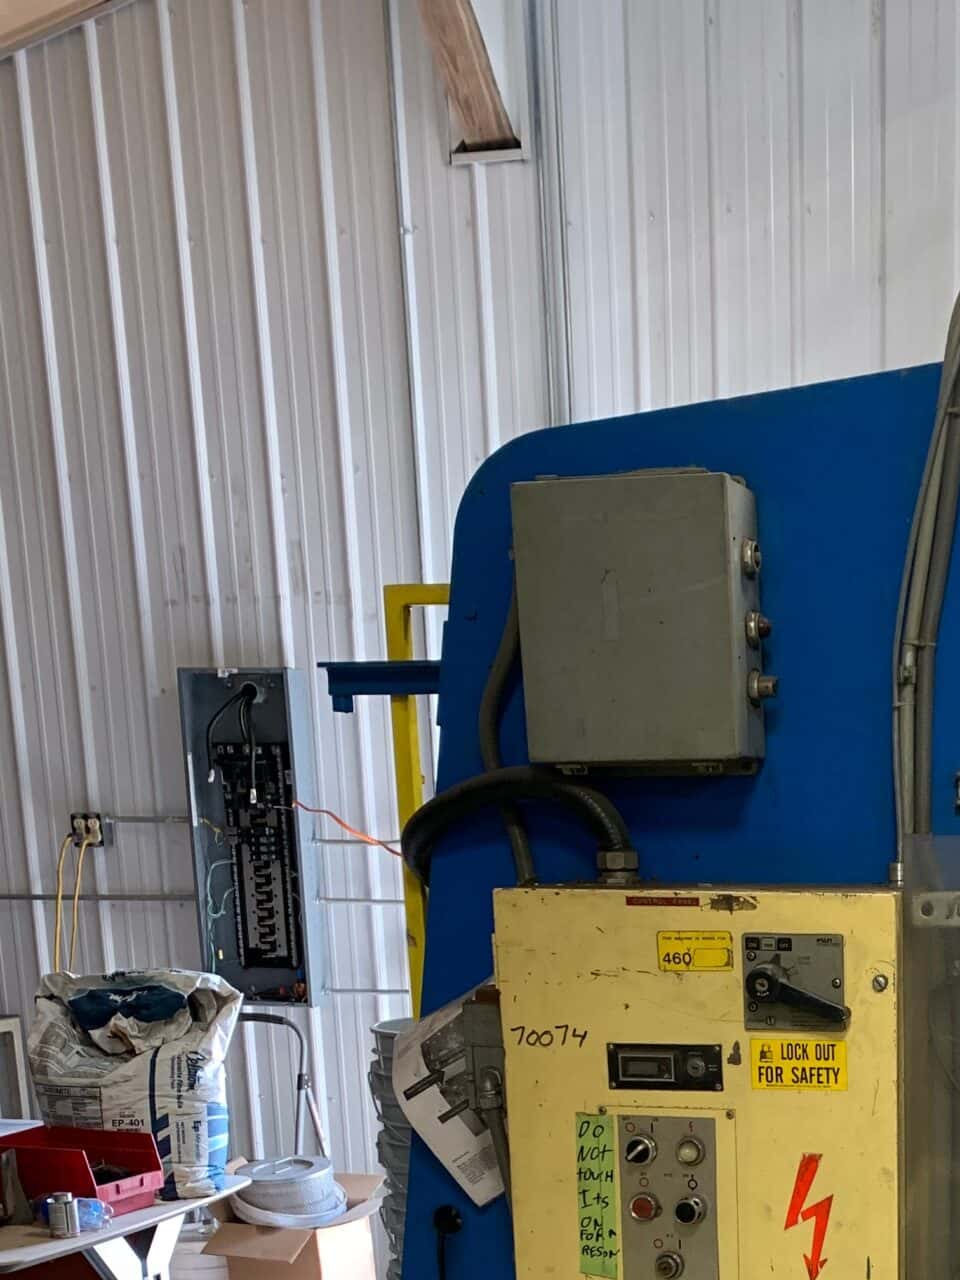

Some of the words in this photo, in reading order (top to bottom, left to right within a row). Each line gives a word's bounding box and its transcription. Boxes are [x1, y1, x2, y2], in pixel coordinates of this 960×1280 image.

[662, 951, 692, 966] 460
[510, 1024, 588, 1048] 70074
[780, 1042, 809, 1061] LOCK
[815, 1043, 836, 1062] OUT
[758, 1065, 783, 1084] FOR
[791, 1066, 841, 1085] SAFETY
[112, 1119, 145, 1128] EP-401
[578, 1120, 605, 1138] DO
[580, 1216, 603, 1230] ON
